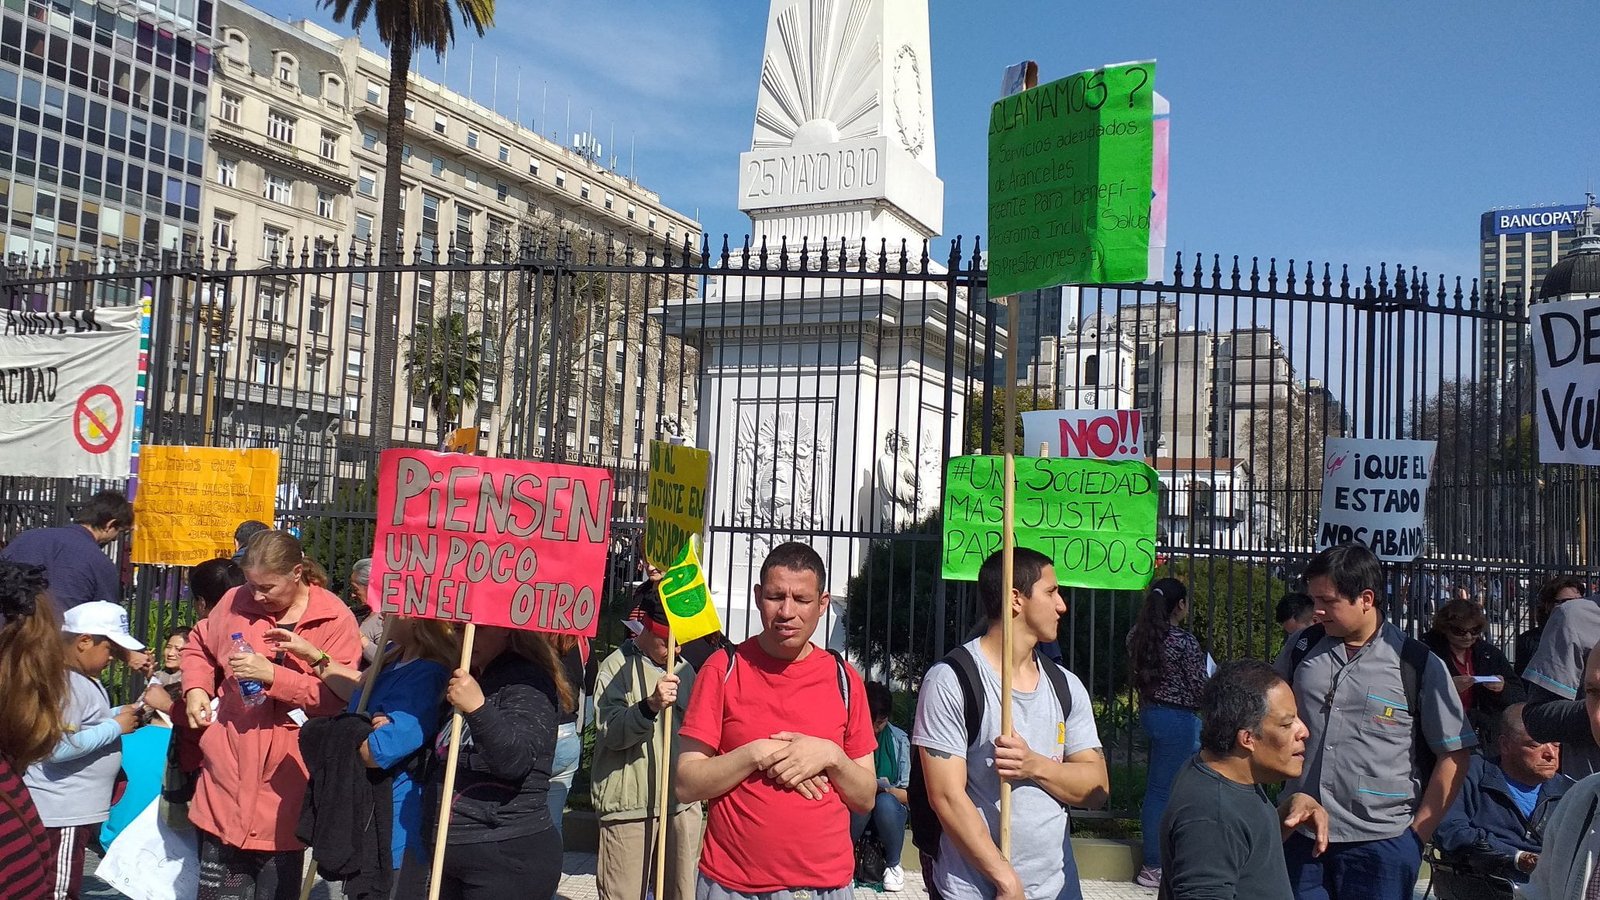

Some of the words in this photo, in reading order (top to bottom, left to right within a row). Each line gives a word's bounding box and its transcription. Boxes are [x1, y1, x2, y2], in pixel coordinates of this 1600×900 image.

[1126, 67, 1148, 108] ?
[999, 137, 1052, 163] Servicios
[747, 158, 775, 197] 25
[780, 152, 830, 195] MAYO
[836, 147, 879, 190] 1810
[1009, 158, 1074, 192] Aranceles
[1101, 205, 1151, 231] Salud
[1501, 209, 1586, 228] BANCOPAT
[1059, 410, 1141, 457] NO!!
[1413, 455, 1427, 480] EL
[949, 494, 1004, 523] MÁS
[1022, 498, 1121, 531] JUSTA
[1335, 486, 1420, 513] ESTADO
[386, 532, 439, 576] UN
[443, 536, 538, 584] POCO
[1040, 536, 1153, 575] TODOS
[381, 572, 432, 616] EN
[436, 577, 473, 621] EL
[510, 582, 597, 631] OTRO
